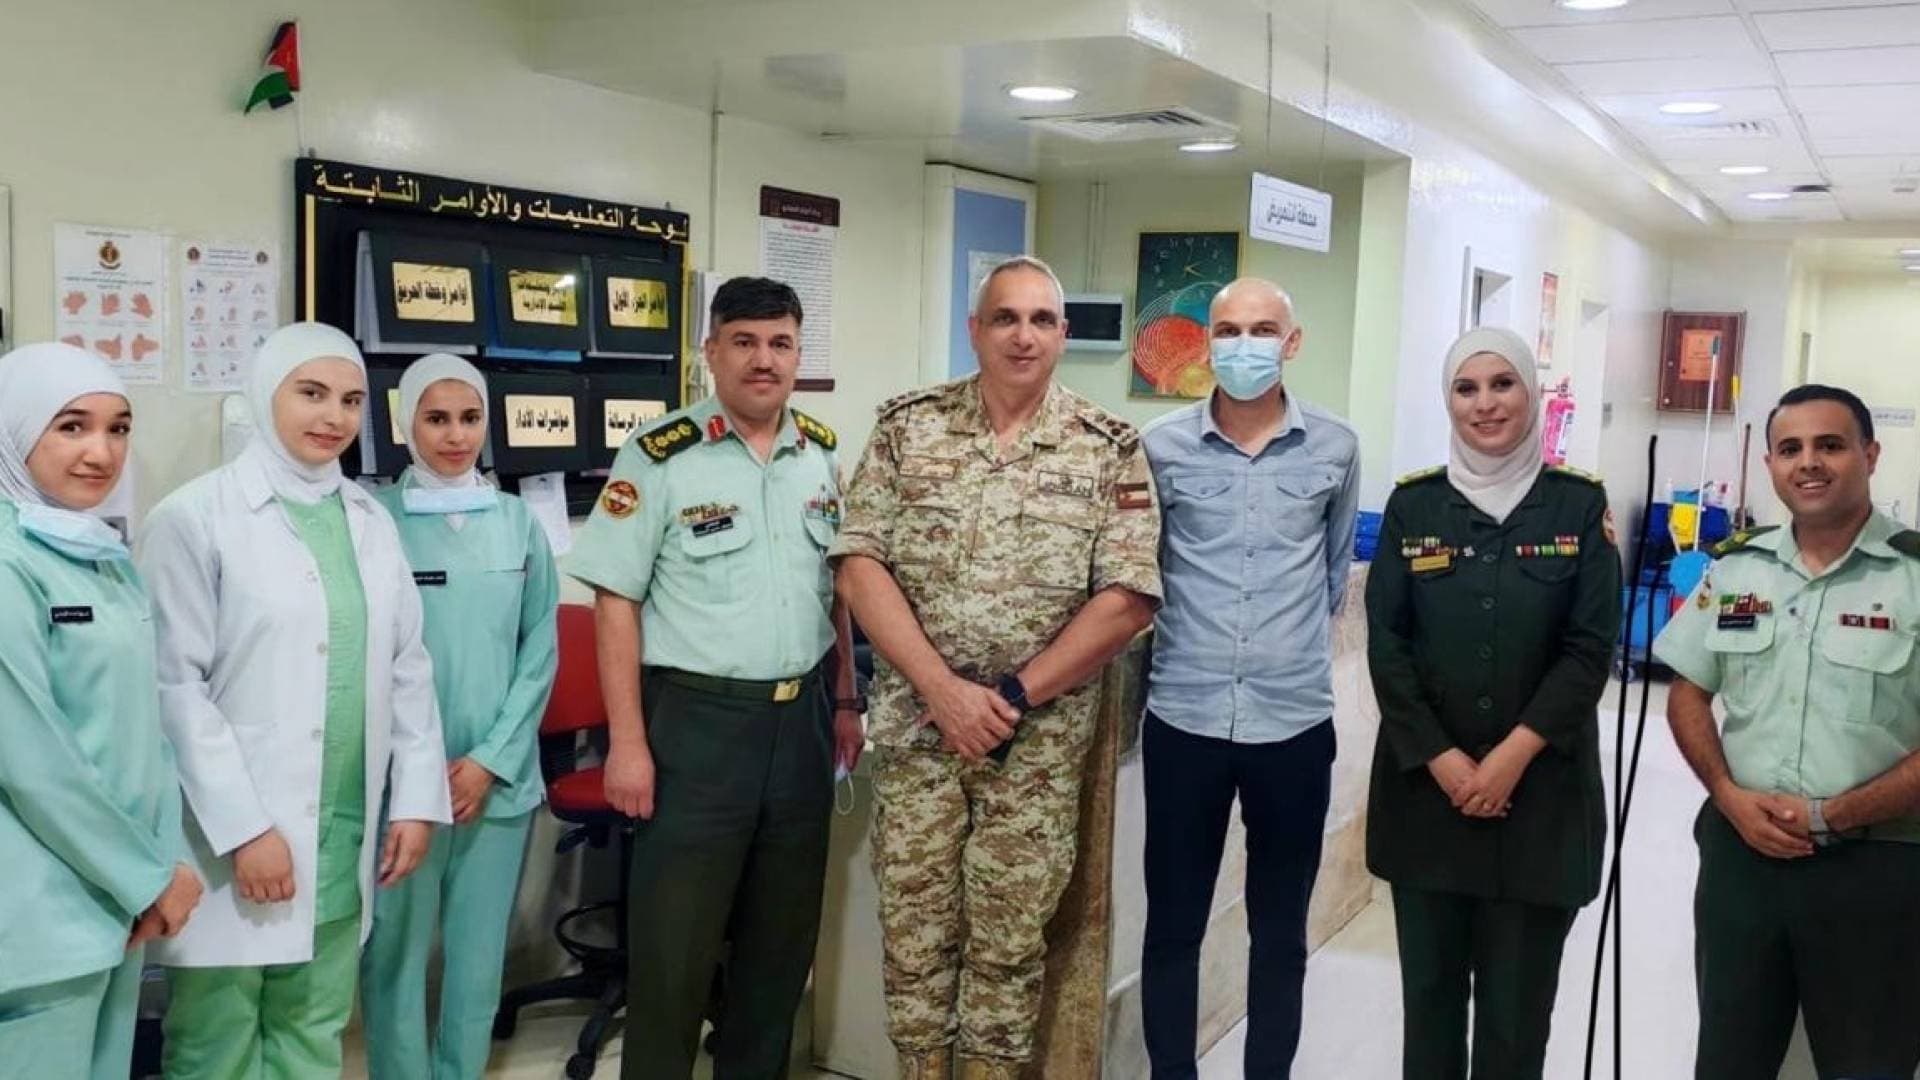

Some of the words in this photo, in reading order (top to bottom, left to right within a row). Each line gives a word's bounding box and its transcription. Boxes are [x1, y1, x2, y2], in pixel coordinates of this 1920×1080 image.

[313, 164, 420, 204] الثابتة
[429, 183, 522, 222] والأوامر
[528, 198, 625, 230] التعليمات
